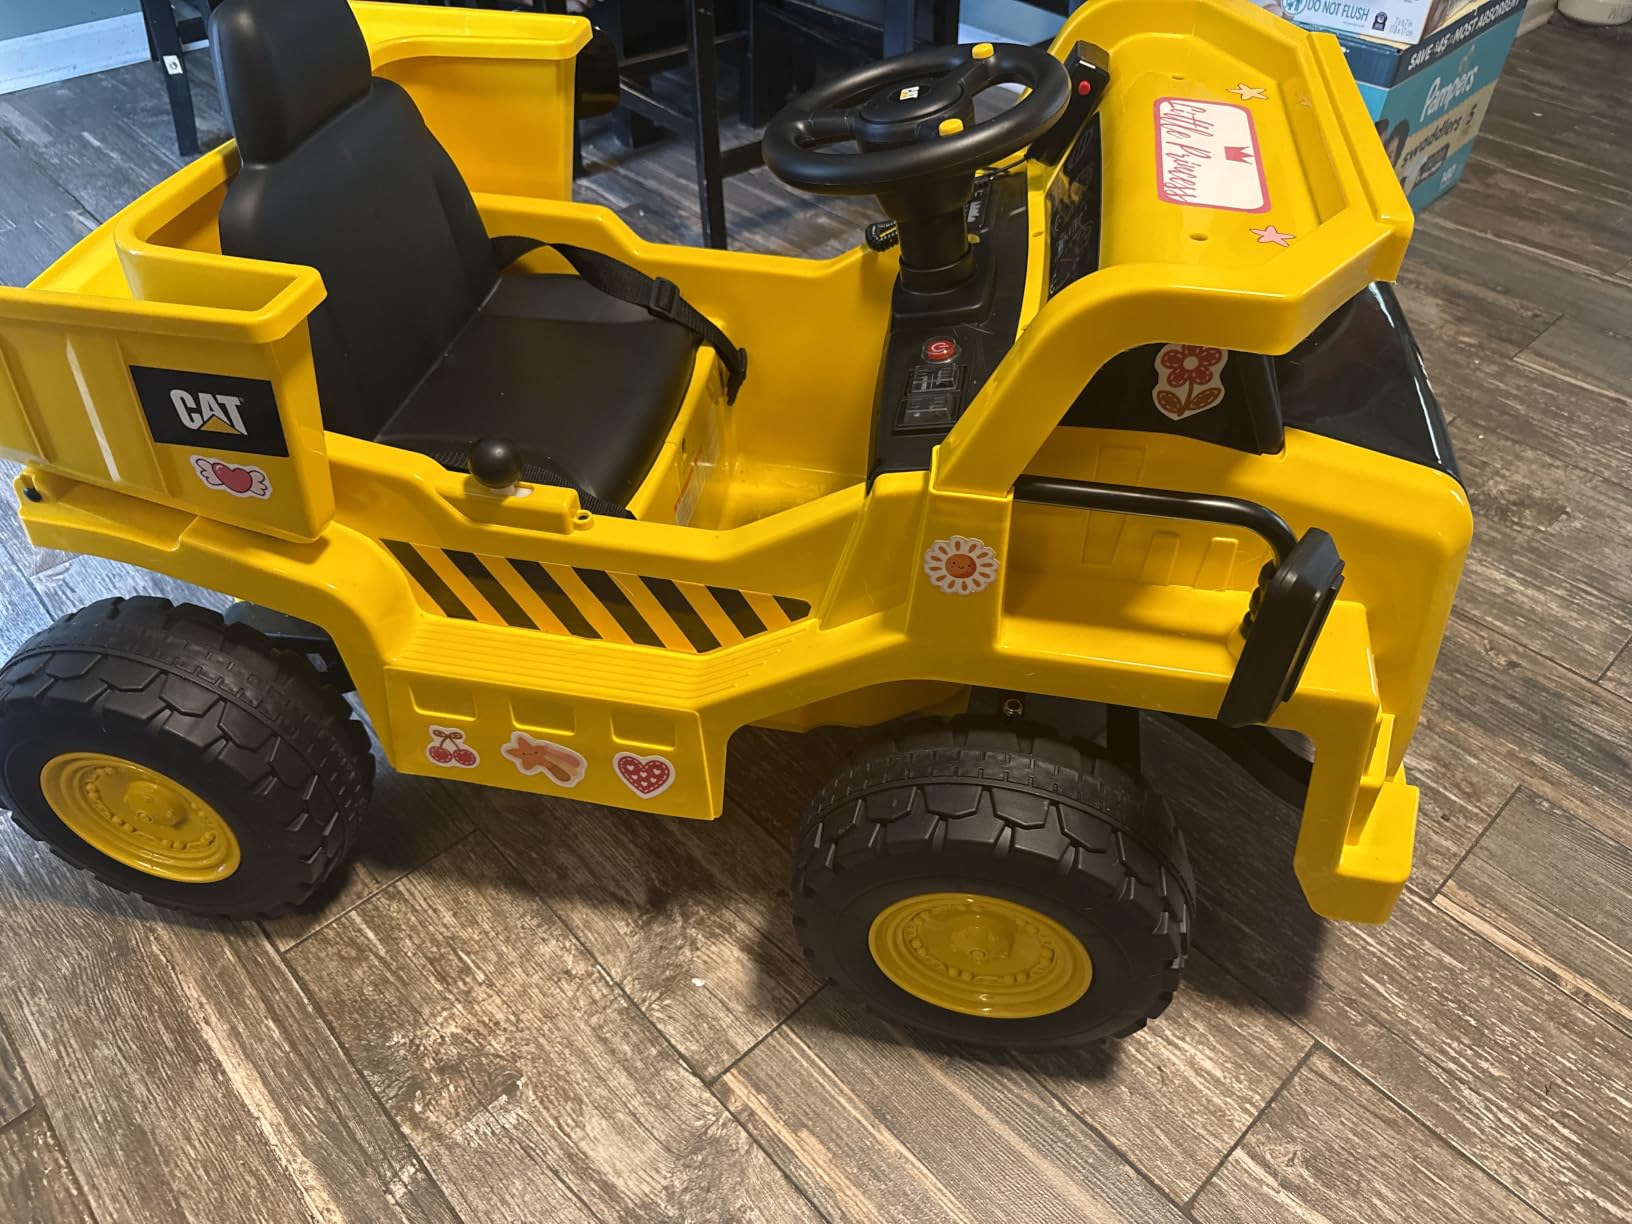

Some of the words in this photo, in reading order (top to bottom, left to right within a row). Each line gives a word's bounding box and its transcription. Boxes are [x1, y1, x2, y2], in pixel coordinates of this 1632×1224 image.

[1307, 0, 1321, 12] DO
[1322, 1, 1341, 16] NOT
[1341, 4, 1369, 22] FLUSH
[1408, 43, 1434, 71] SAVE
[1452, 17, 1479, 45] MOST
[1420, 65, 1478, 122] Pampers
[1160, 100, 1215, 139] Little
[1163, 141, 1213, 203] Princess
[170, 389, 248, 435] CAT
